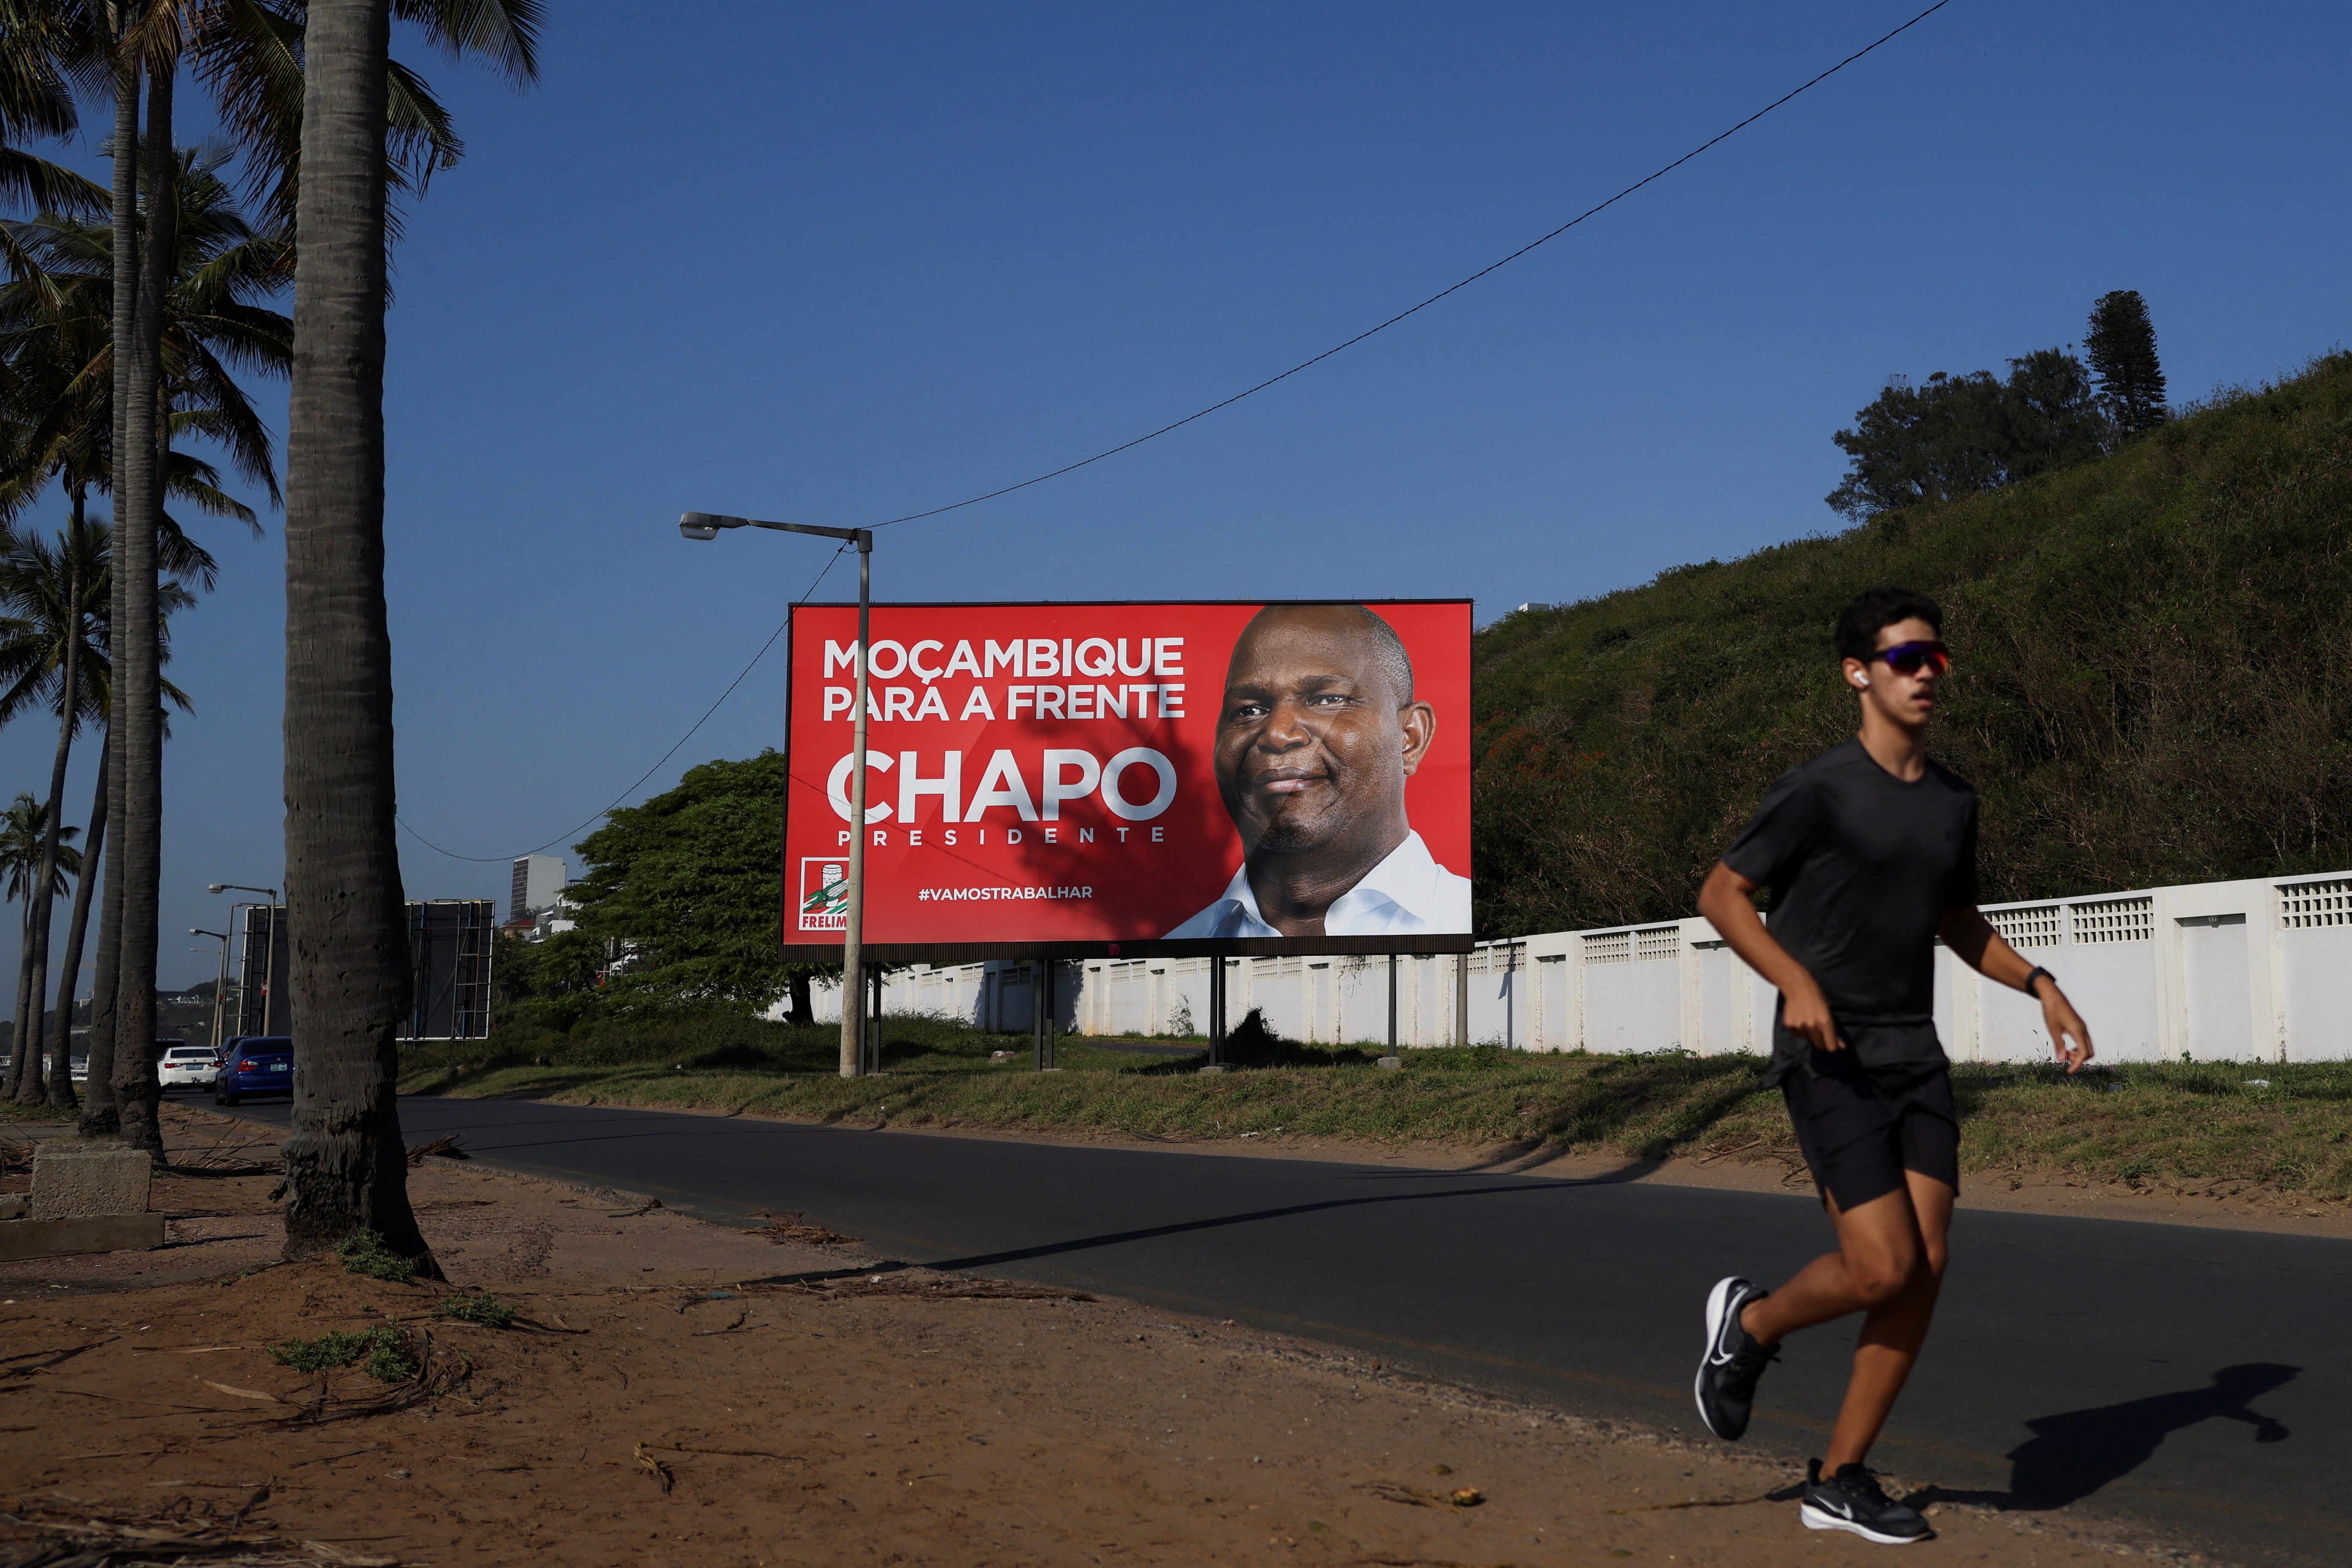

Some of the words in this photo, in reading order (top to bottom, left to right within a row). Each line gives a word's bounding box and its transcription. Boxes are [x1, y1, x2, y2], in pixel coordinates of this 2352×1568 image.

[824, 638, 1184, 685] MOÇAMBIQUE
[823, 686, 949, 721] PARA
[960, 686, 995, 721] A
[1008, 684, 1185, 720] FRENTE
[827, 747, 1177, 824] CHAPO
[838, 827, 1164, 846] PRESIDENTE
[919, 886, 1092, 901] #VAMOSTRABALHAR
[802, 916, 847, 928] FRELIM
